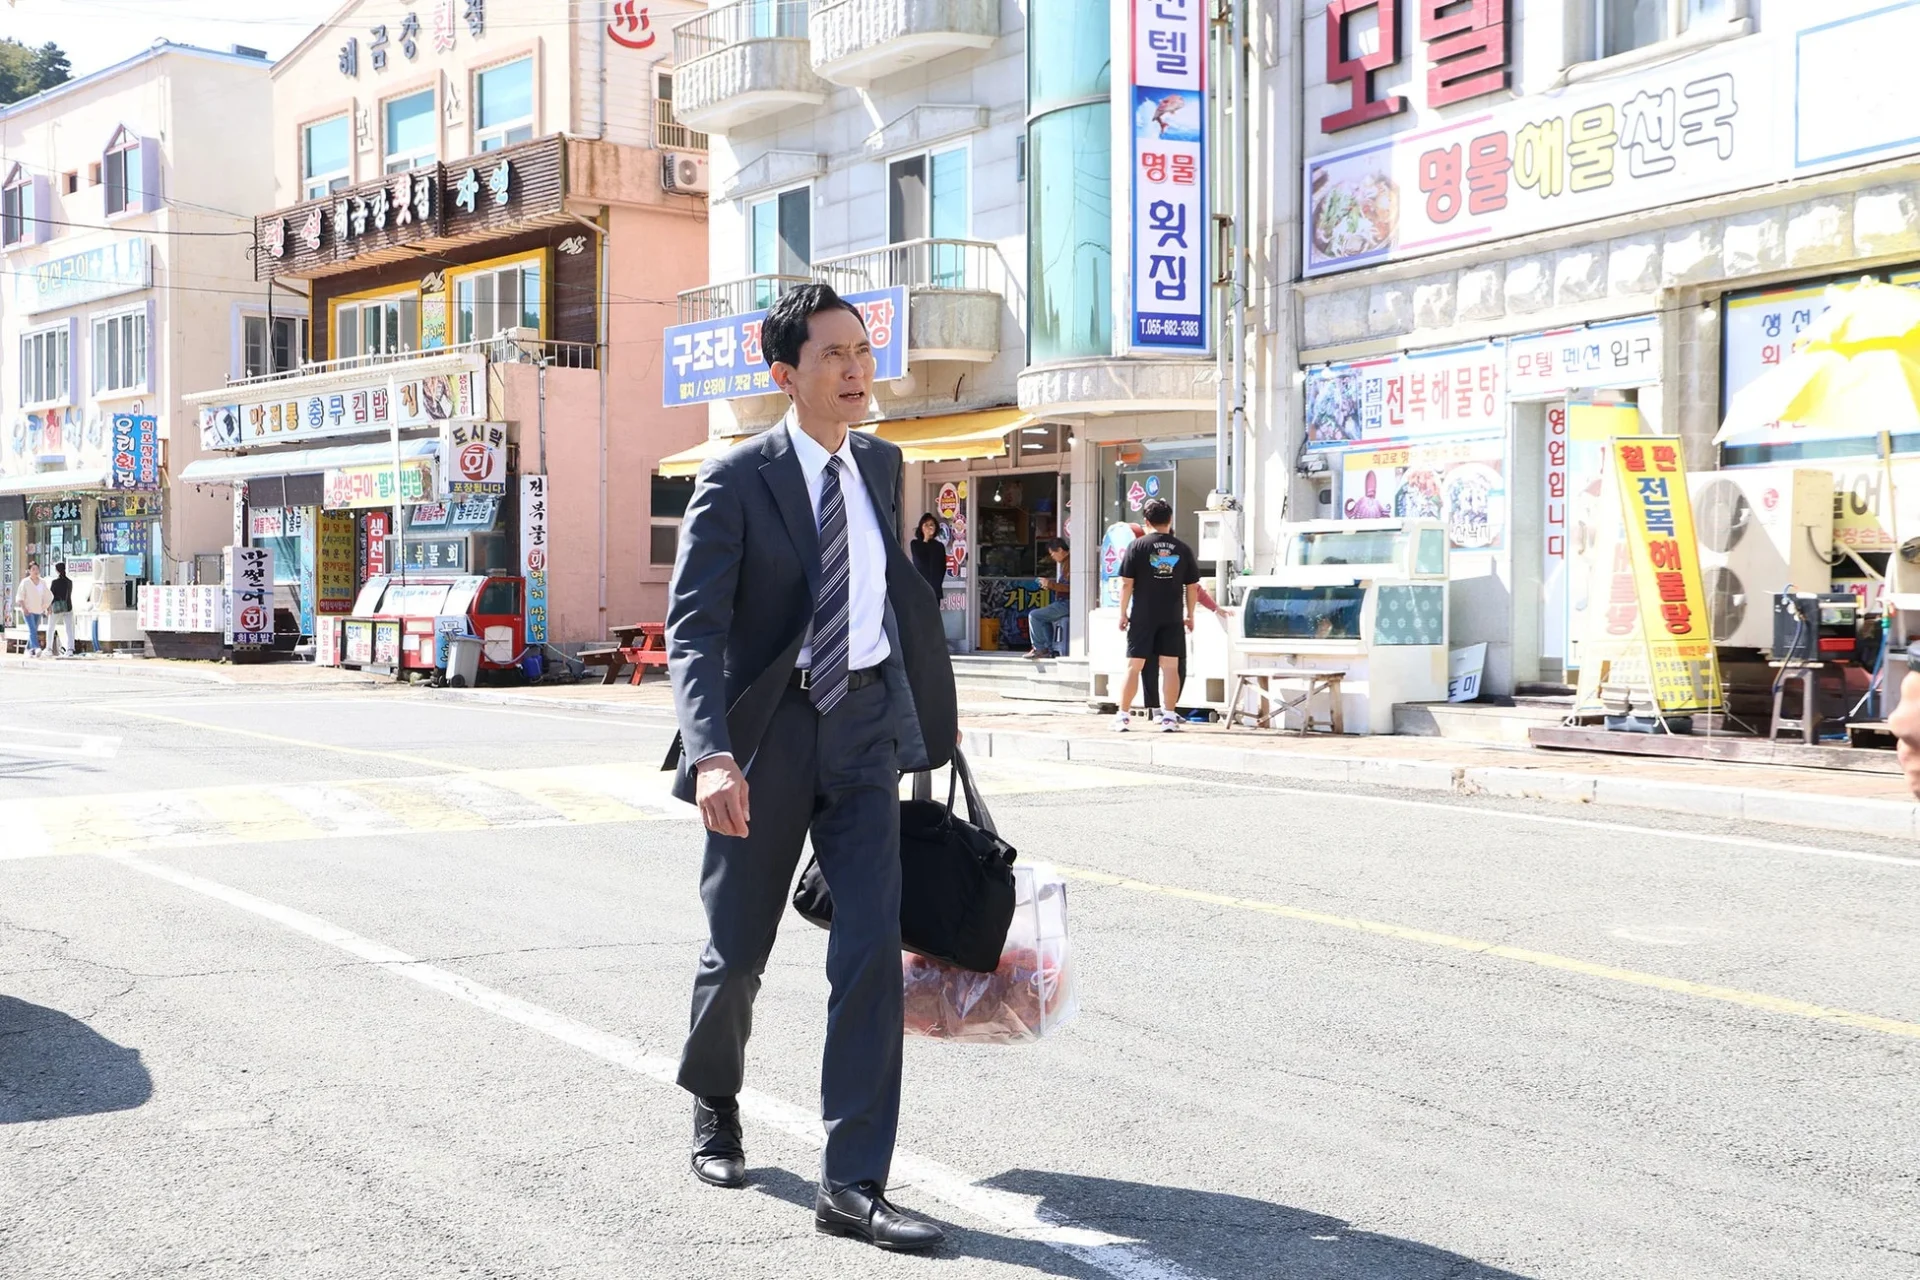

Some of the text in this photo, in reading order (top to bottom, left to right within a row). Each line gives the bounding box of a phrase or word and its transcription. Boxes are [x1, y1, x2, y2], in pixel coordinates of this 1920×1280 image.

[1142, 152, 1196, 185] 명물
[264, 206, 323, 258] 펜션
[455, 158, 511, 214] 자연
[1149, 200, 1188, 301] 횟집
[1140, 318, 1199, 337] T.055-682-3383
[671, 326, 737, 376] 구조라
[1516, 352, 1553, 377] 모텔
[1611, 337, 1652, 367] 입구
[459, 374, 468, 415] 생선구이
[703, 374, 726, 395] 오징어
[753, 371, 770, 388] 직판
[1386, 363, 1499, 426] 전복해물탕
[307, 393, 345, 429] 충무
[352, 387, 389, 426] 김밥
[400, 382, 418, 418] 집
[452, 423, 503, 448] 도시락
[462, 444, 490, 477] 회
[1620, 446, 1677, 472] 철판
[333, 473, 373, 503] 생선구이
[453, 483, 501, 494] 포장됩니다
[1637, 477, 1692, 635] 전복해물탕
[322, 575, 351, 585] 전복죽
[531, 570, 545, 639] 멸치쌈밥
[1004, 587, 1050, 611] 거제
[238, 633, 271, 643] 회덮밥
[377, 627, 393, 641] 생선
